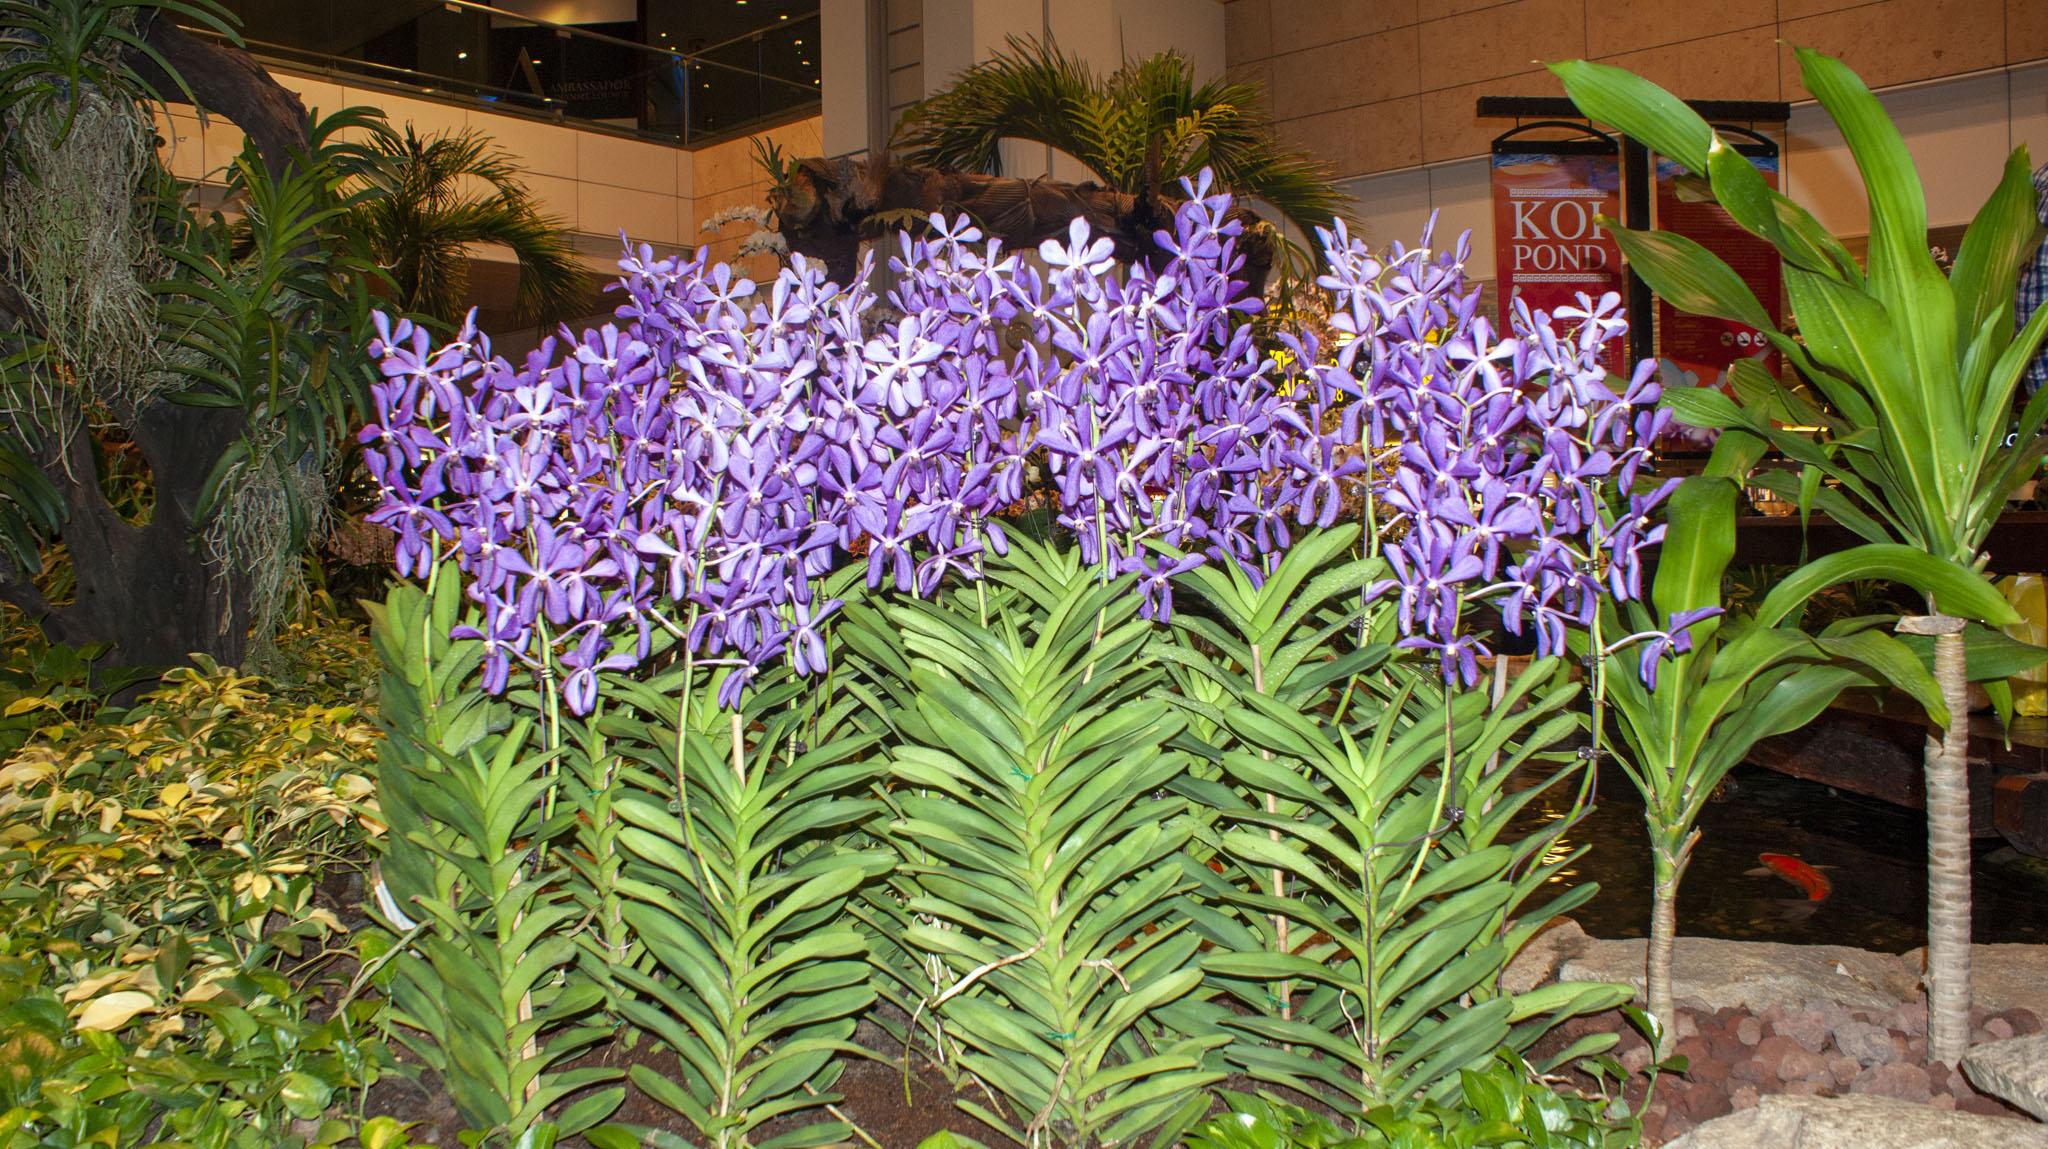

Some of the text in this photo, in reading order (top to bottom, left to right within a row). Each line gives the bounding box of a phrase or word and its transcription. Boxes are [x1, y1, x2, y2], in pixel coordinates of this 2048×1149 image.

[551, 80, 632, 93] AMBASSADOR
[1510, 200, 1606, 240] KOI
[1512, 244, 1607, 271] POND
